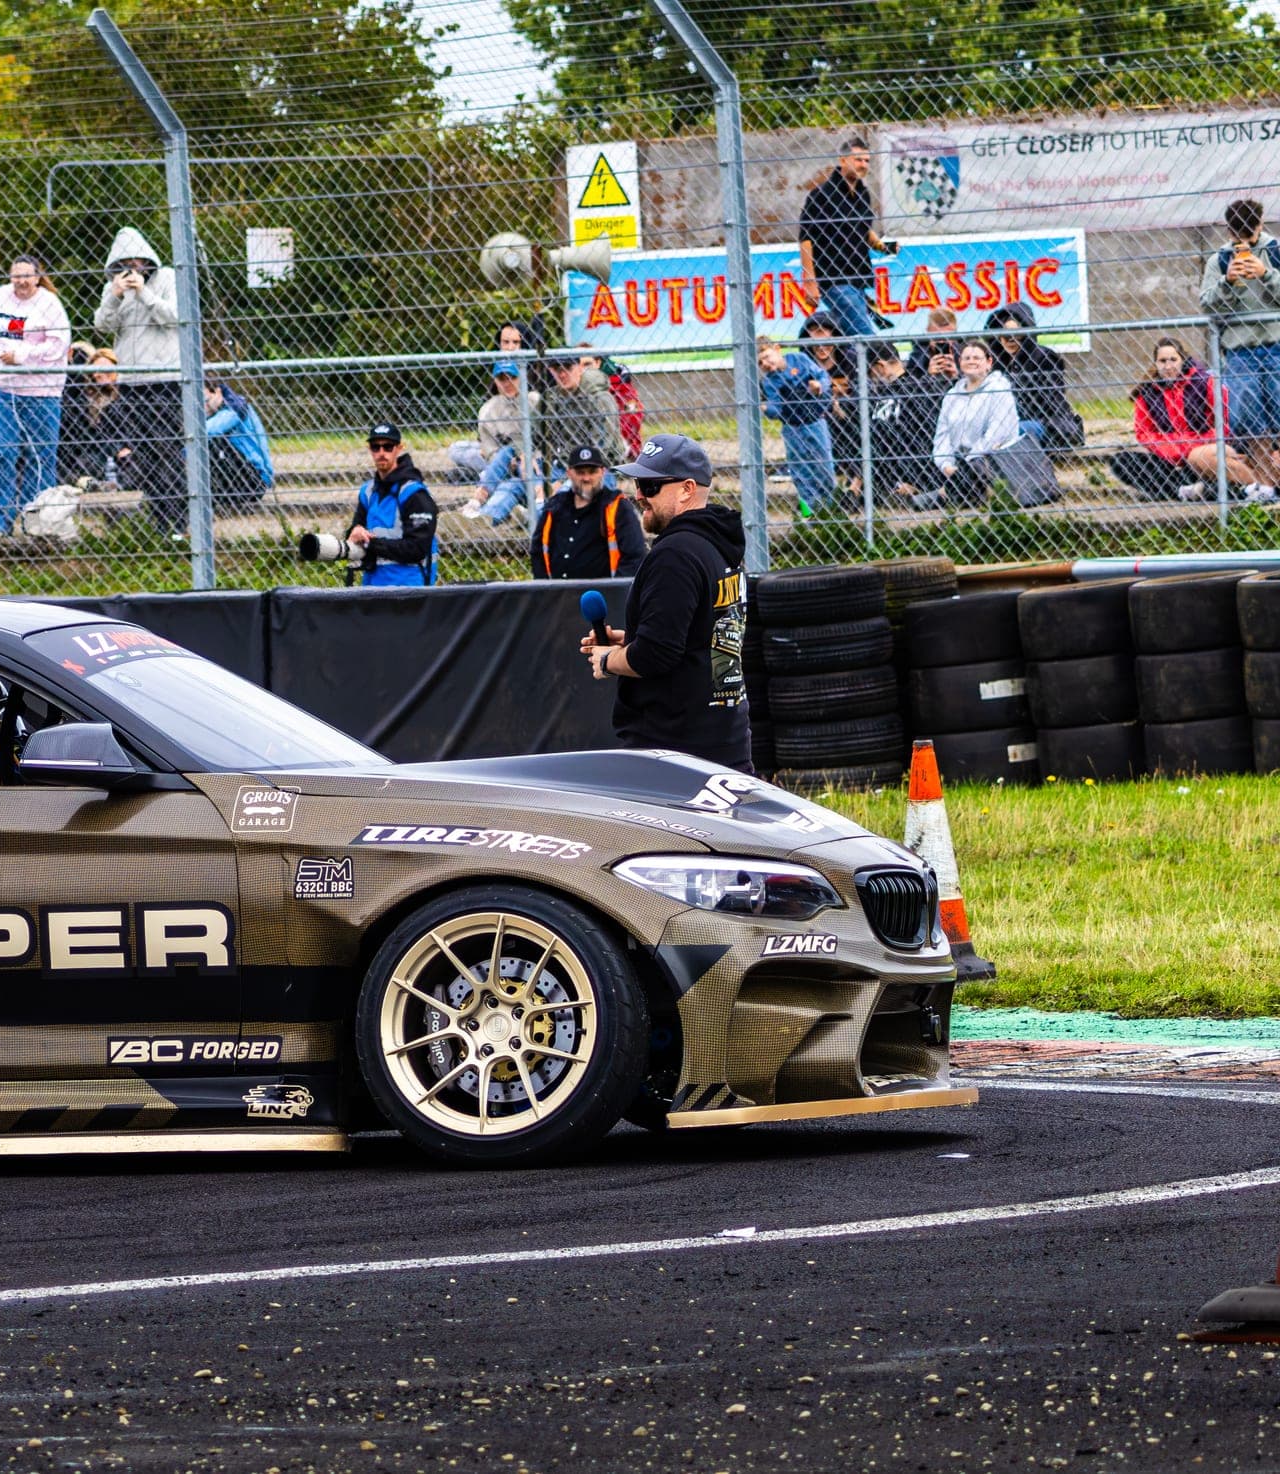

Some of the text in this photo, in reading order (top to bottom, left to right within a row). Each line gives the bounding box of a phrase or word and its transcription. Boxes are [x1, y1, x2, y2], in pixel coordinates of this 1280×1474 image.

[972, 137, 1010, 157] GET
[1017, 132, 1095, 155] CLOSER
[1099, 130, 1126, 151] TO
[1129, 129, 1170, 149] THE
[1176, 122, 1253, 147] ACTION
[585, 219, 625, 231] Danger
[875, 258, 1062, 313] LASSIC
[238, 817, 286, 826] GARAGE
[331, 882, 353, 892] BBC
[763, 935, 838, 956] LZMFG
[110, 1040, 280, 1063] BC FORGED
